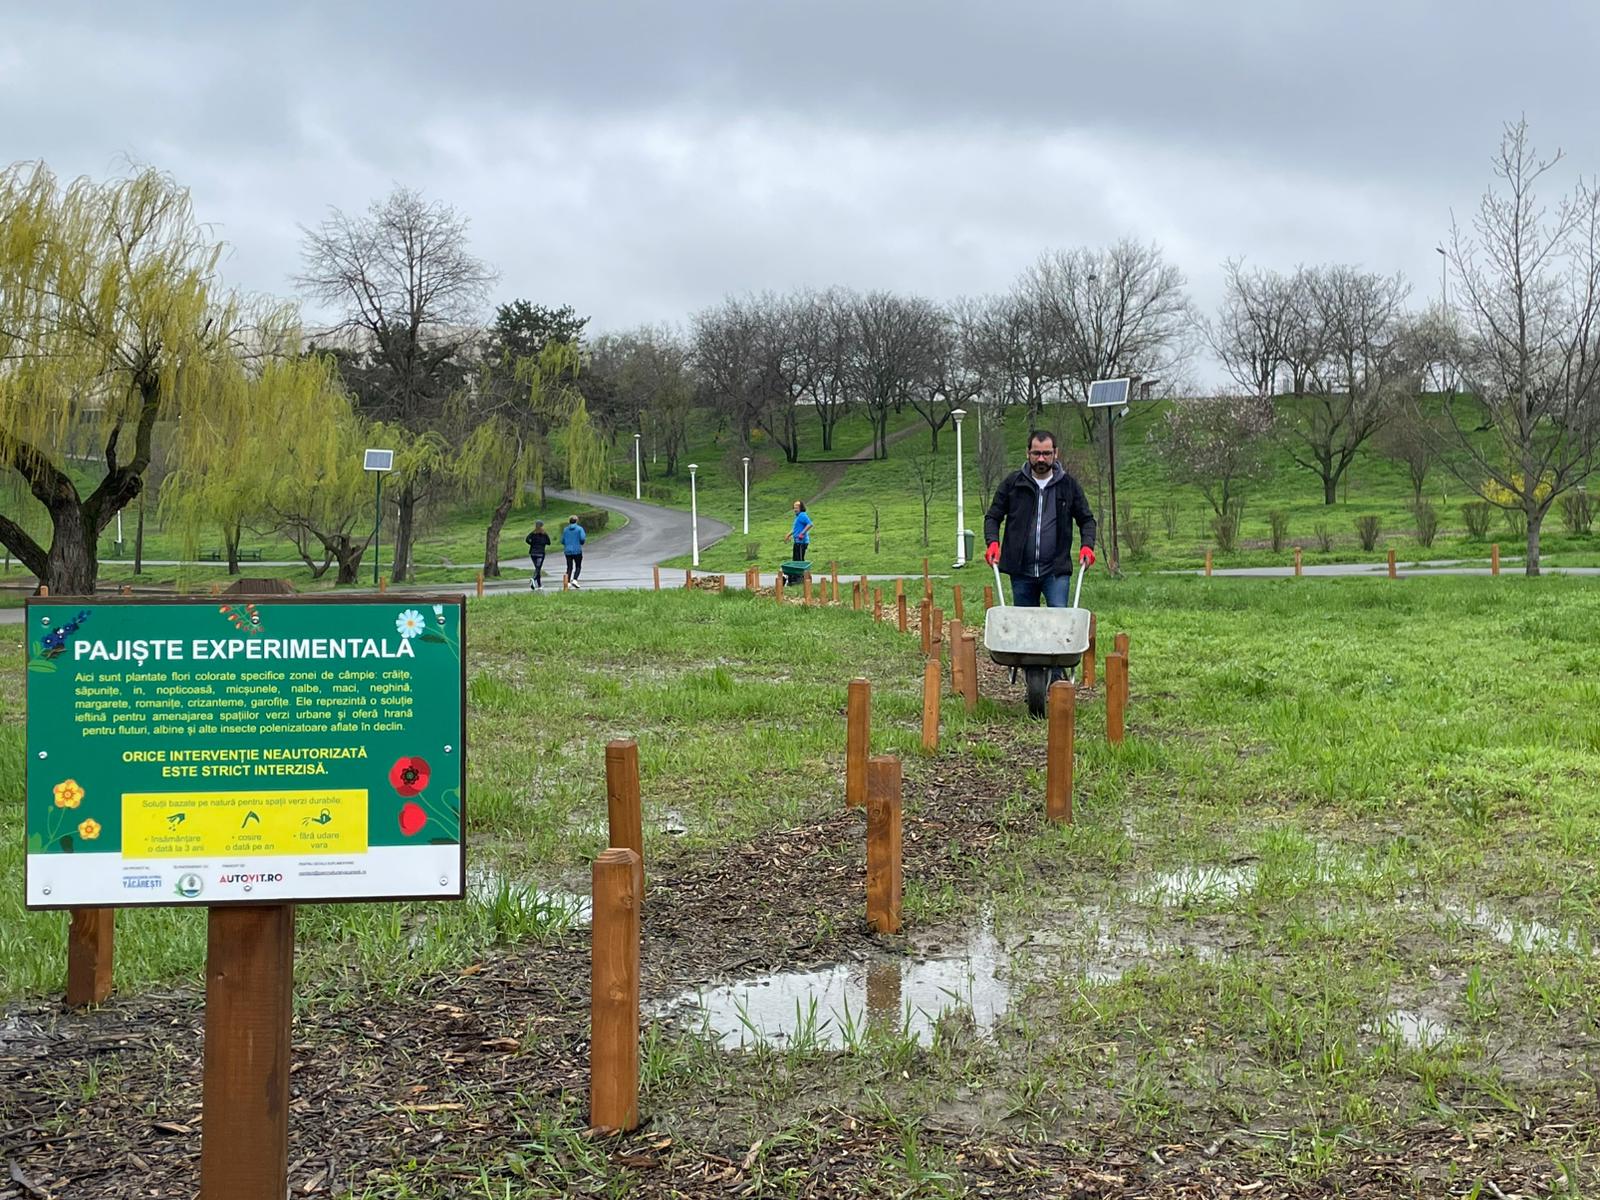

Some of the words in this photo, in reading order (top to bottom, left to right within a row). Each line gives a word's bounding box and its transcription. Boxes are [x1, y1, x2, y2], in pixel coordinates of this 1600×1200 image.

[74, 639, 184, 666] PAJIȘTE
[74, 672, 94, 682] Aici
[98, 672, 121, 682] sunt
[125, 672, 167, 683] plantate
[171, 671, 190, 681] flori
[194, 671, 236, 681] colorate
[240, 670, 285, 682] specifice
[289, 671, 317, 680] zonei
[320, 670, 334, 680] de
[382, 669, 413, 682] crăițe,
[74, 685, 122, 697] săpunițe,
[156, 684, 215, 696] nopticoasă,
[225, 684, 280, 696] micșunele,
[291, 683, 321, 694] nalbe,
[332, 683, 359, 693] maci,
[369, 682, 412, 694] neghină,
[74, 699, 131, 711] margarete,
[135, 698, 183, 709] romanițe,
[187, 698, 246, 707] crizanteme,
[295, 696, 312, 706] Ele
[316, 695, 366, 708] reprezintă
[369, 697, 377, 705] o
[380, 695, 413, 707] soluție
[74, 711, 107, 722] ieftină
[112, 712, 146, 723] pentru
[151, 711, 213, 723] amenajarea
[219, 710, 259, 722] spațiilor
[265, 711, 290, 720] verzi
[295, 709, 331, 719] urbane
[337, 709, 346, 721] și
[351, 708, 378, 719] oferă
[384, 708, 413, 718] hrană
[82, 726, 116, 737] pentru
[118, 725, 150, 735] fluturi,
[152, 724, 184, 734] albine
[186, 724, 196, 736] și
[198, 724, 218, 734] alte
[220, 723, 257, 733] insecte
[259, 723, 328, 734] polenizatoare
[330, 721, 358, 732] aflate
[360, 721, 371, 731] în
[122, 750, 166, 762] ORICE
[169, 749, 259, 763] INTERVENȚIE
[263, 746, 368, 760] NEAUTORIZATĂ
[162, 765, 198, 777] ESTE
[201, 764, 251, 776] STRICT
[254, 761, 328, 776] INTERZISĂ.
[220, 873, 282, 883] AUTOVIT.RO
